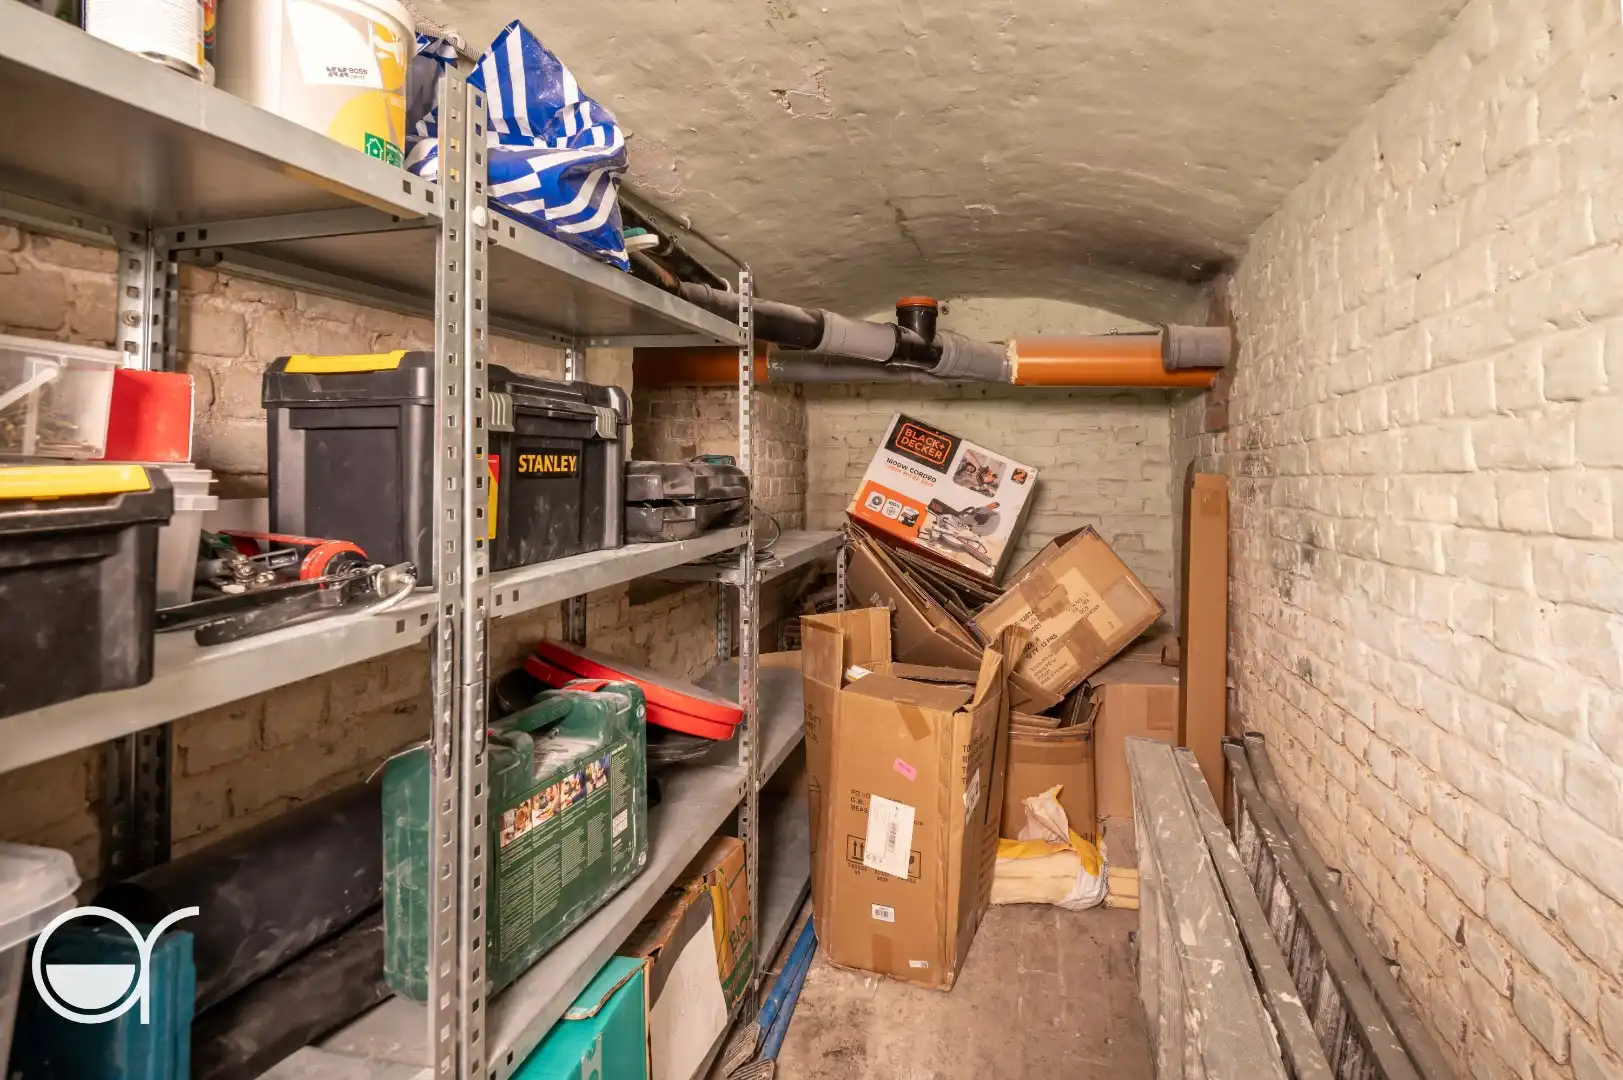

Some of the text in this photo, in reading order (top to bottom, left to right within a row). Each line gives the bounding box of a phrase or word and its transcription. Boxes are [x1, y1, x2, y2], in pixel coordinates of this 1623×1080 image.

[349, 67, 368, 75] BOSS
[901, 436, 943, 460] DECKER
[905, 428, 945, 449] BLACK+
[518, 454, 577, 473] STANLEY
[909, 467, 937, 483] CORDED
